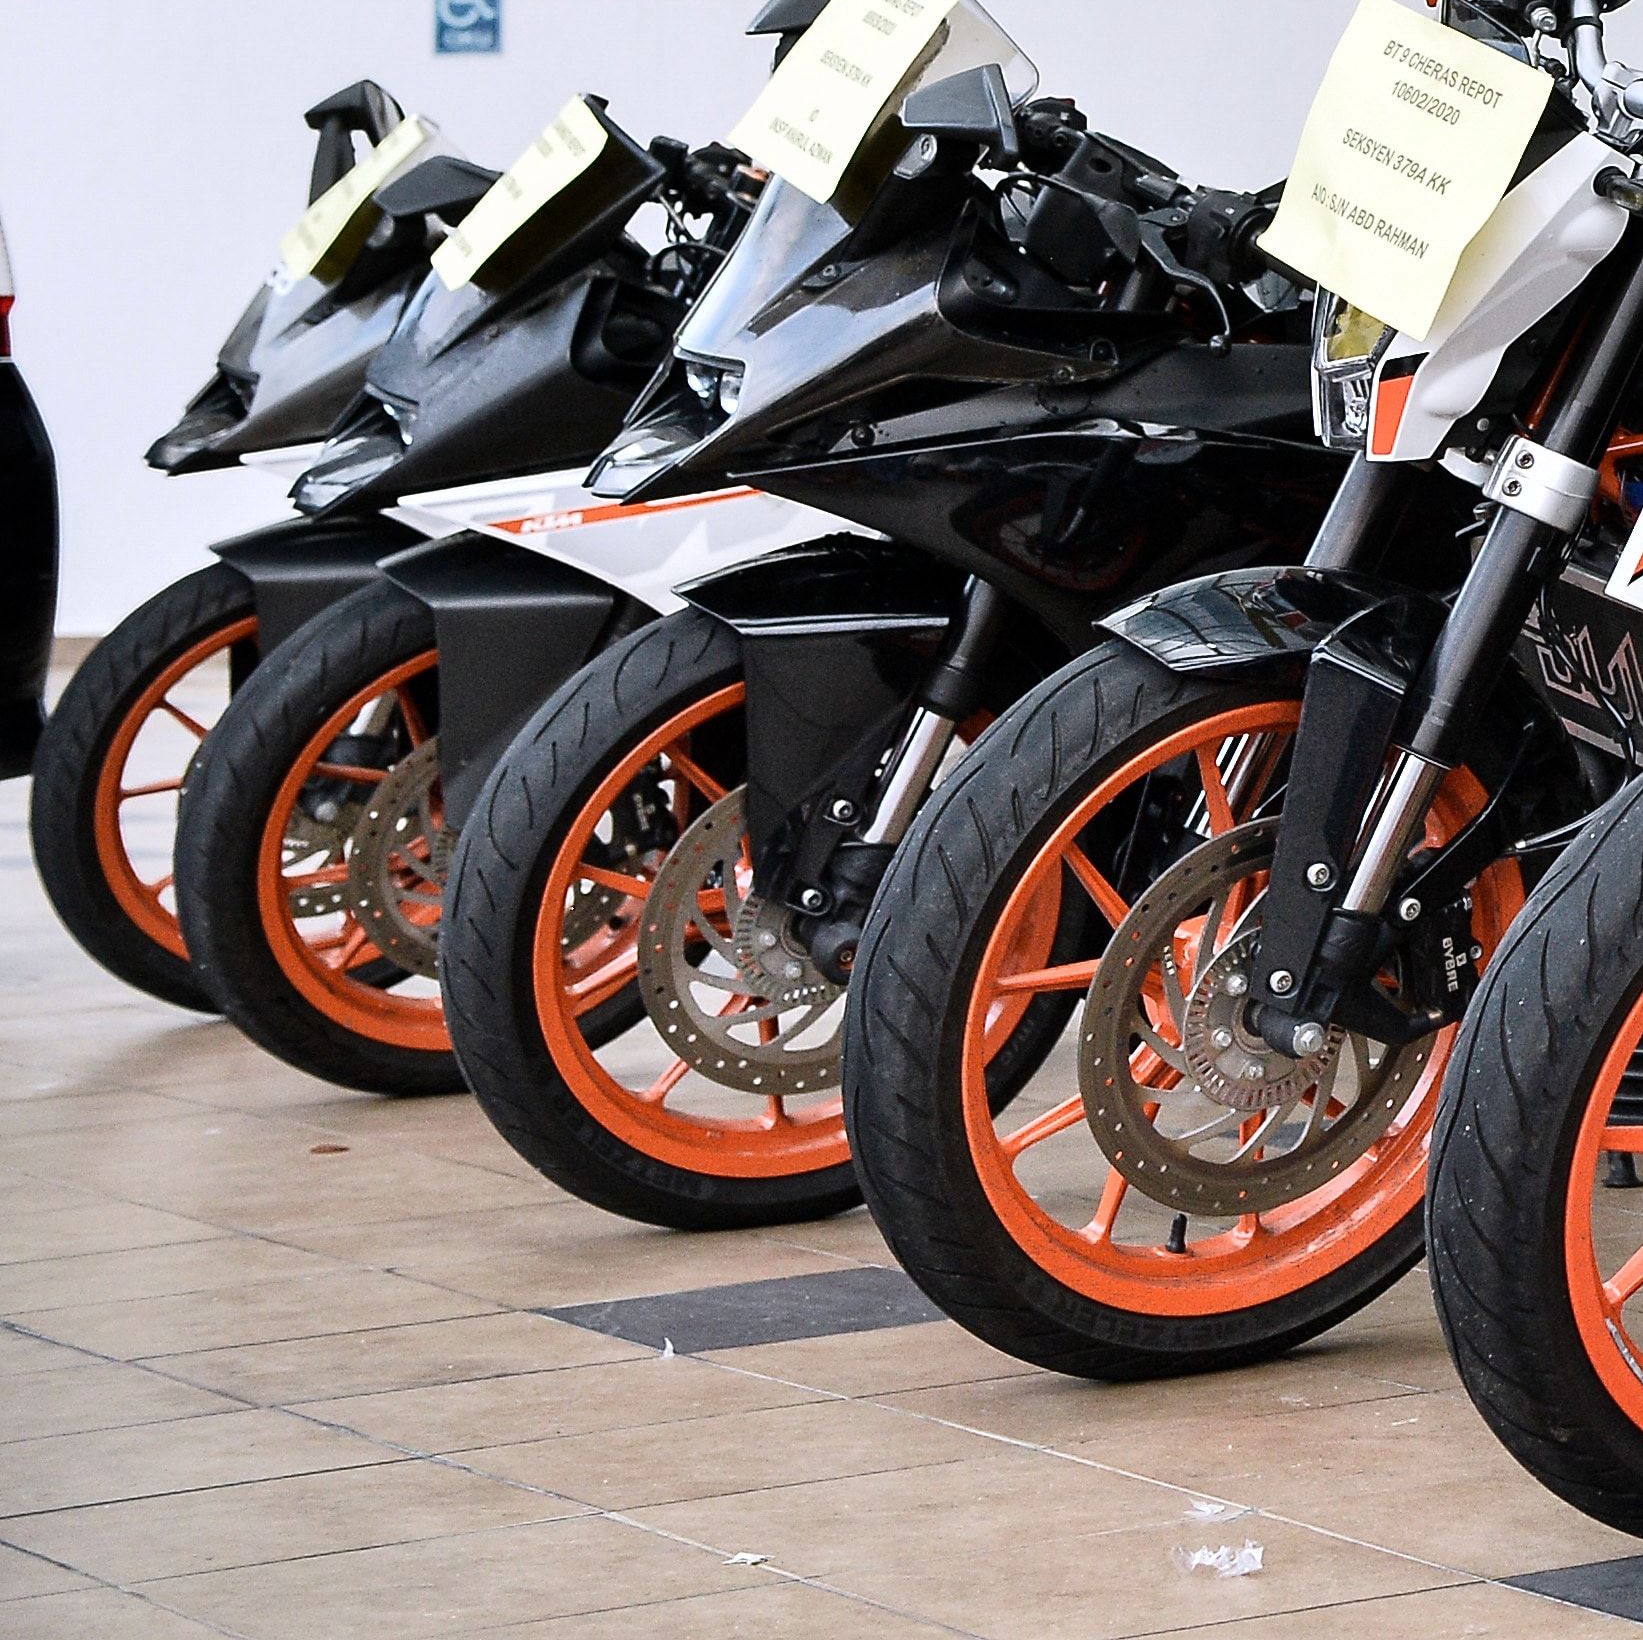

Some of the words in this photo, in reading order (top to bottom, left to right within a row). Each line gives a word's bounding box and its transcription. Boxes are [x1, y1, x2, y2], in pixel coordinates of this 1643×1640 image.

[1383, 40, 1403, 58] BT
[1408, 52, 1459, 89] CHERAS
[1457, 73, 1504, 110] REPOT
[1391, 79, 1462, 126] 10602/2020
[1342, 127, 1396, 167] SEKSYEN
[1392, 153, 1429, 184] 379A
[1426, 172, 1453, 196] KK
[1346, 204, 1375, 232] ABD
[1373, 218, 1431, 261] RAHMAN
